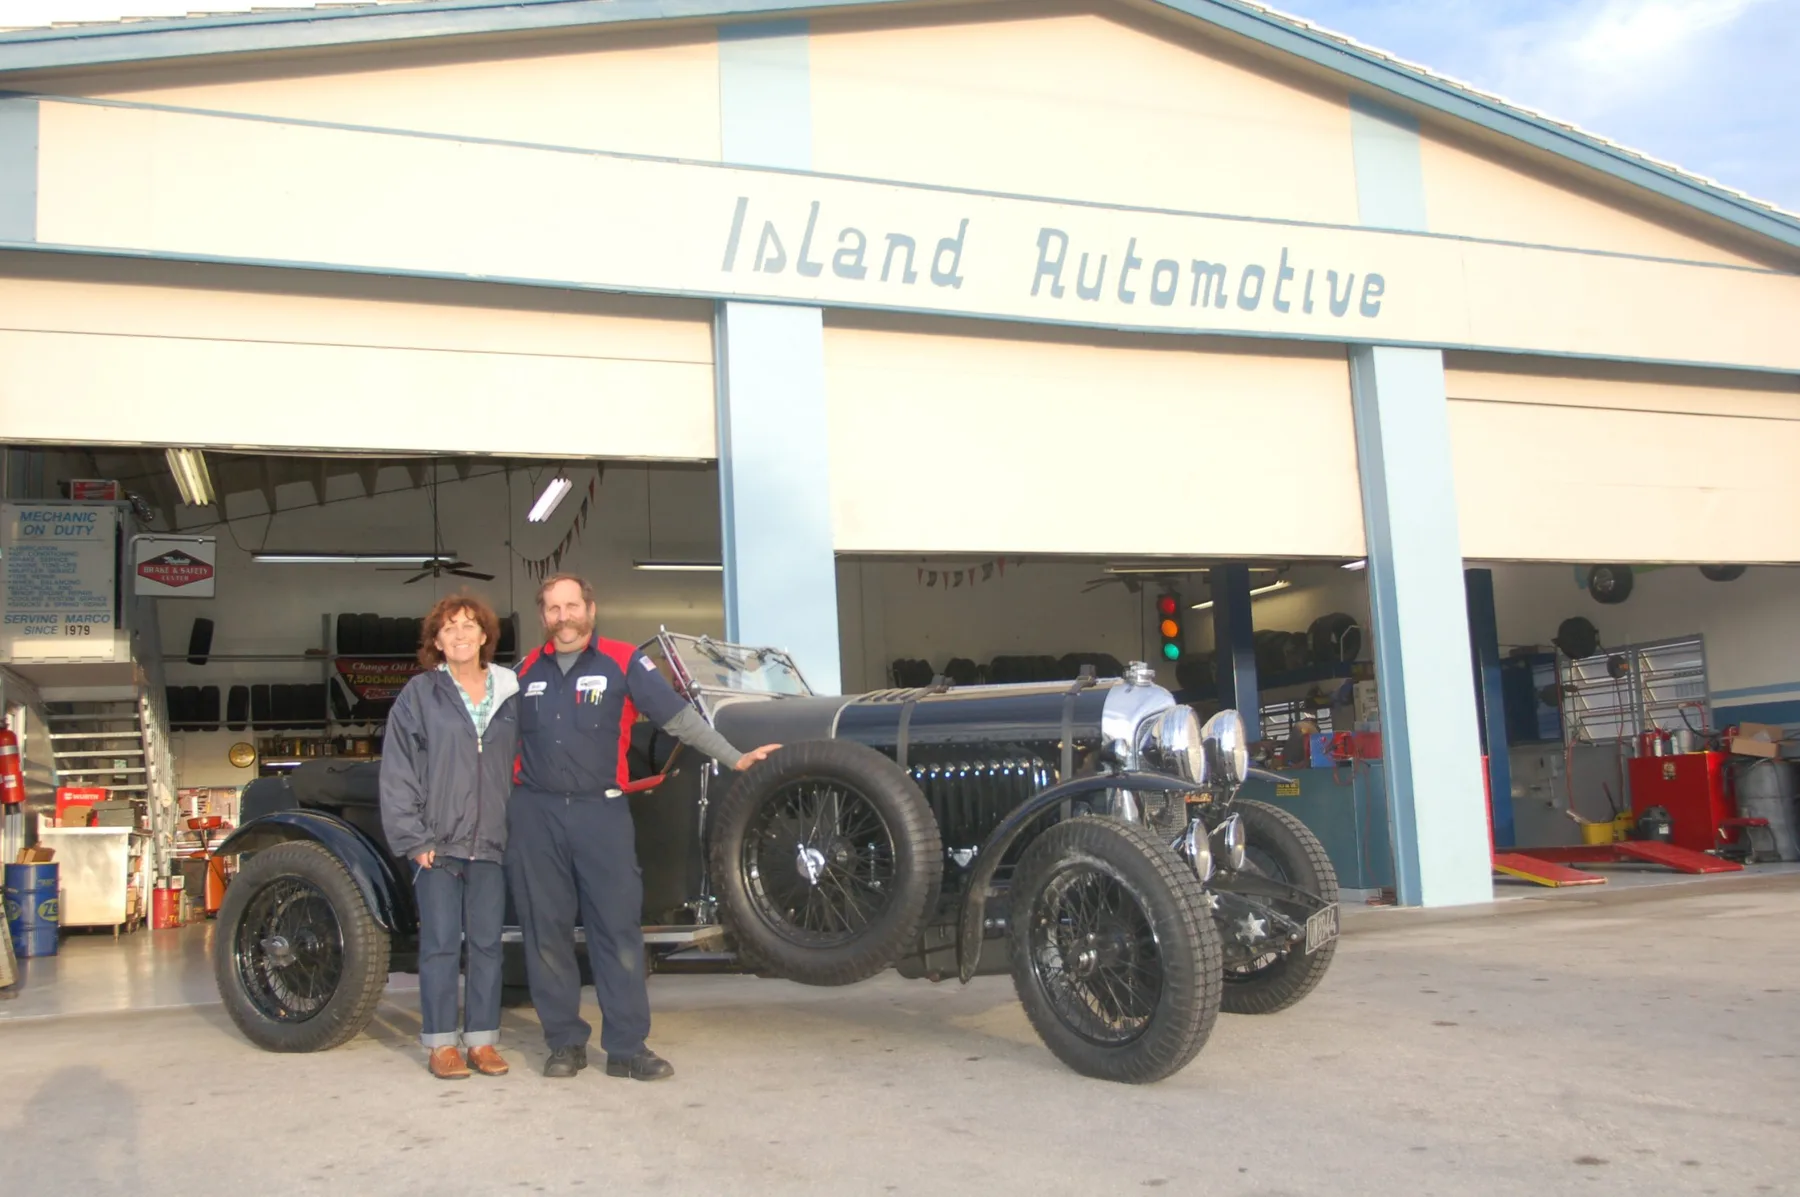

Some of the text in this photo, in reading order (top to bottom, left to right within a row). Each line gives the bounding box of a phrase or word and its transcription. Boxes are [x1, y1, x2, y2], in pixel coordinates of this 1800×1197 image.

[721, 196, 1386, 318] Island Automotive
[20, 511, 97, 522] MECHANIC
[23, 524, 94, 536] ON DUTY
[143, 566, 208, 575] BRAKE & SAFETY
[4, 614, 110, 624] SERVING MARCO
[24, 625, 90, 636] SINCE 1979
[352, 662, 388, 673] Change
[391, 663, 407, 671] Oil
